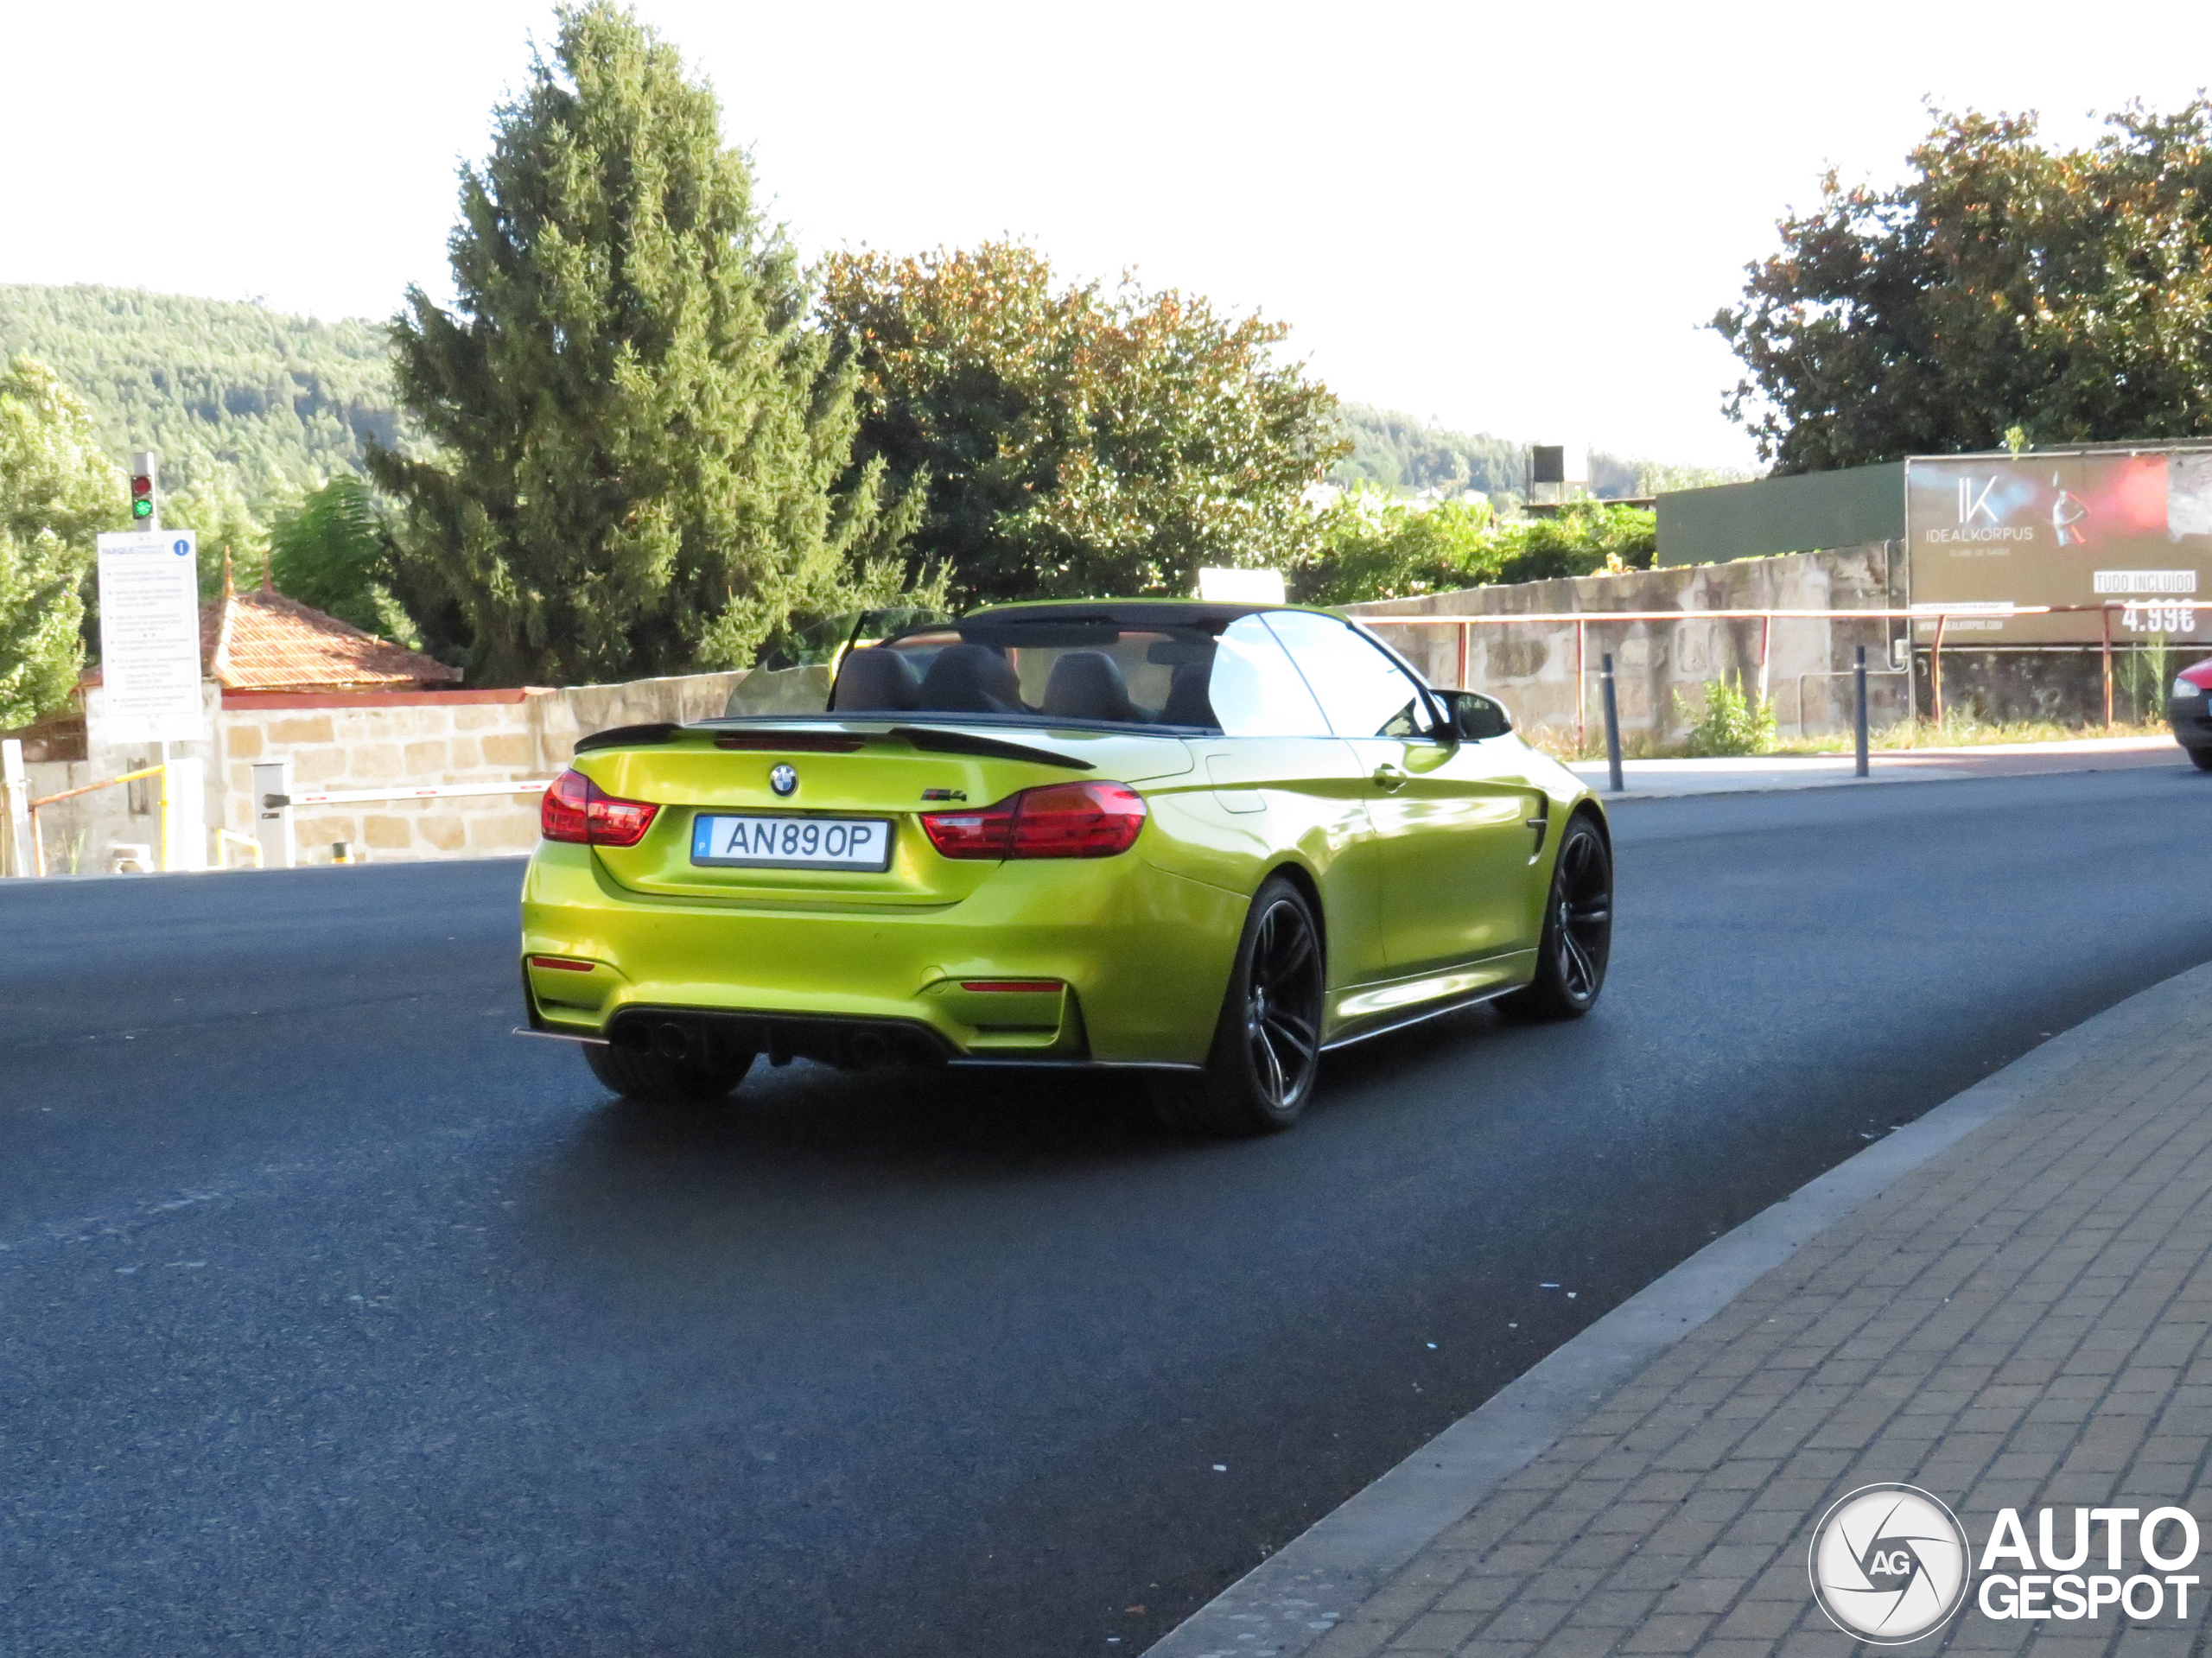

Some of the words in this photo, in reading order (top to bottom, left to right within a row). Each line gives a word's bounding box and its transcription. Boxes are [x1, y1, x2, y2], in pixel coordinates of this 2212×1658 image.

[1926, 527, 2033, 543] IDEALKORPUS
[2097, 575, 2128, 591] TUDO
[2122, 598, 2196, 632] 4.99€
[698, 842, 706, 851] P
